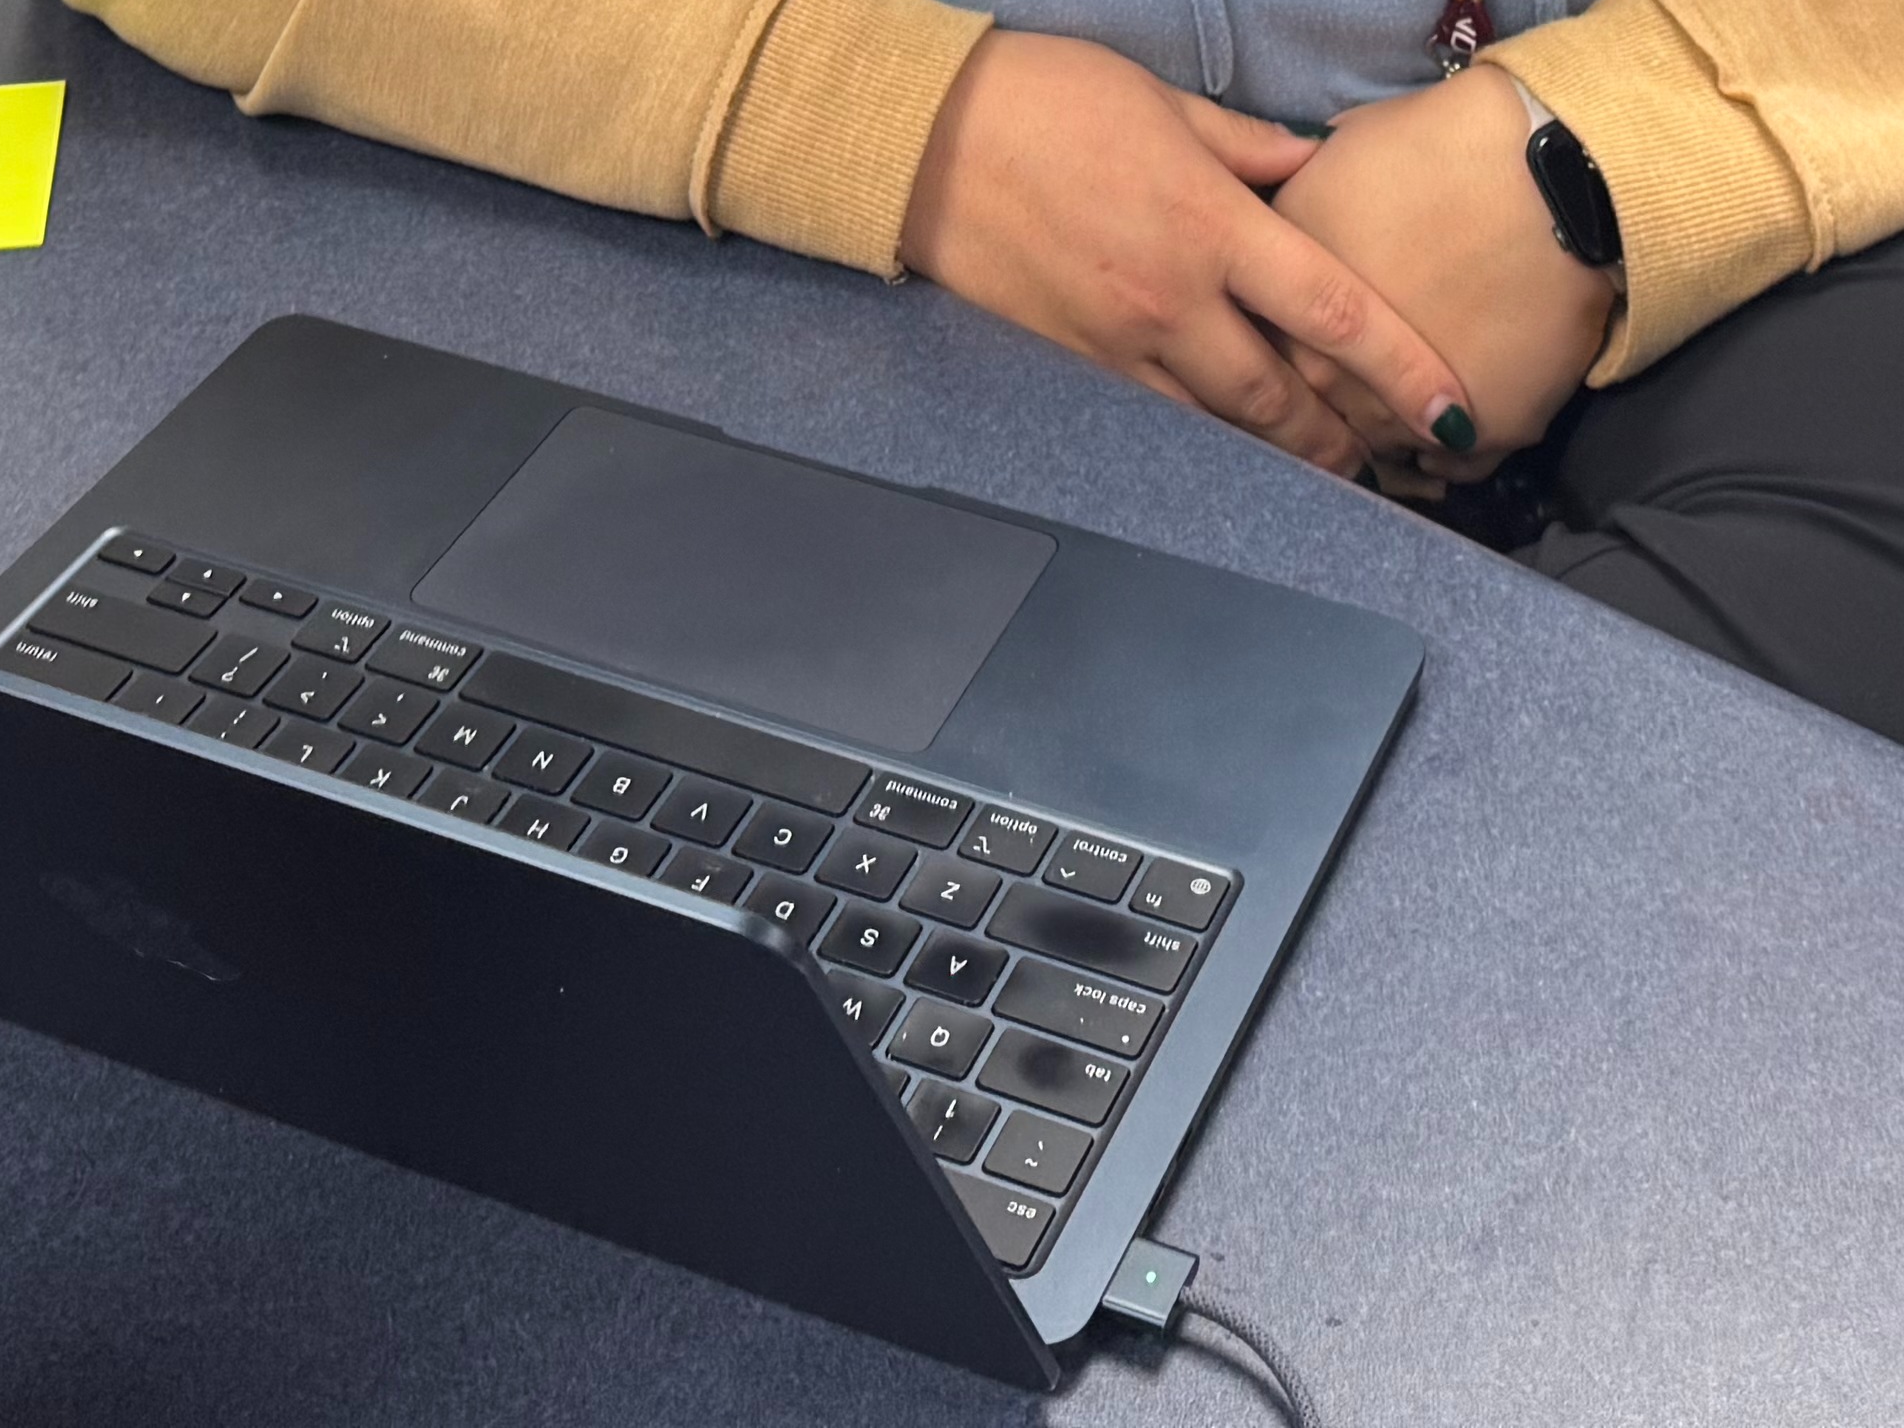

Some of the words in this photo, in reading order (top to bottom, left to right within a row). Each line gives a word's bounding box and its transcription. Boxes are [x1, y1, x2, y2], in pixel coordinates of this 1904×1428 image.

[66, 590, 99, 610] shift
[330, 608, 375, 629] option
[15, 641, 59, 663] return
[400, 628, 467, 657] command
[453, 725, 477, 746] M
[532, 750, 554, 770] N
[369, 768, 392, 789] K
[612, 776, 631, 795] B
[885, 779, 958, 811] command
[690, 802, 709, 822] V
[526, 818, 550, 840] H
[990, 812, 1038, 836] option
[773, 828, 793, 847] C
[610, 846, 629, 865] G
[1073, 838, 1128, 863] control
[855, 854, 877, 874] X
[940, 881, 961, 901] Z
[1145, 892, 1162, 909] fn
[775, 900, 795, 921] D
[859, 928, 880, 948] S
[1143, 932, 1180, 952] shift
[949, 955, 968, 976] A
[1073, 983, 1105, 1005] lock
[842, 997, 863, 1021] W
[1109, 995, 1147, 1015] caps
[930, 1025, 950, 1048] Q
[1084, 1062, 1112, 1083] tab
[1006, 1200, 1038, 1220] esc
